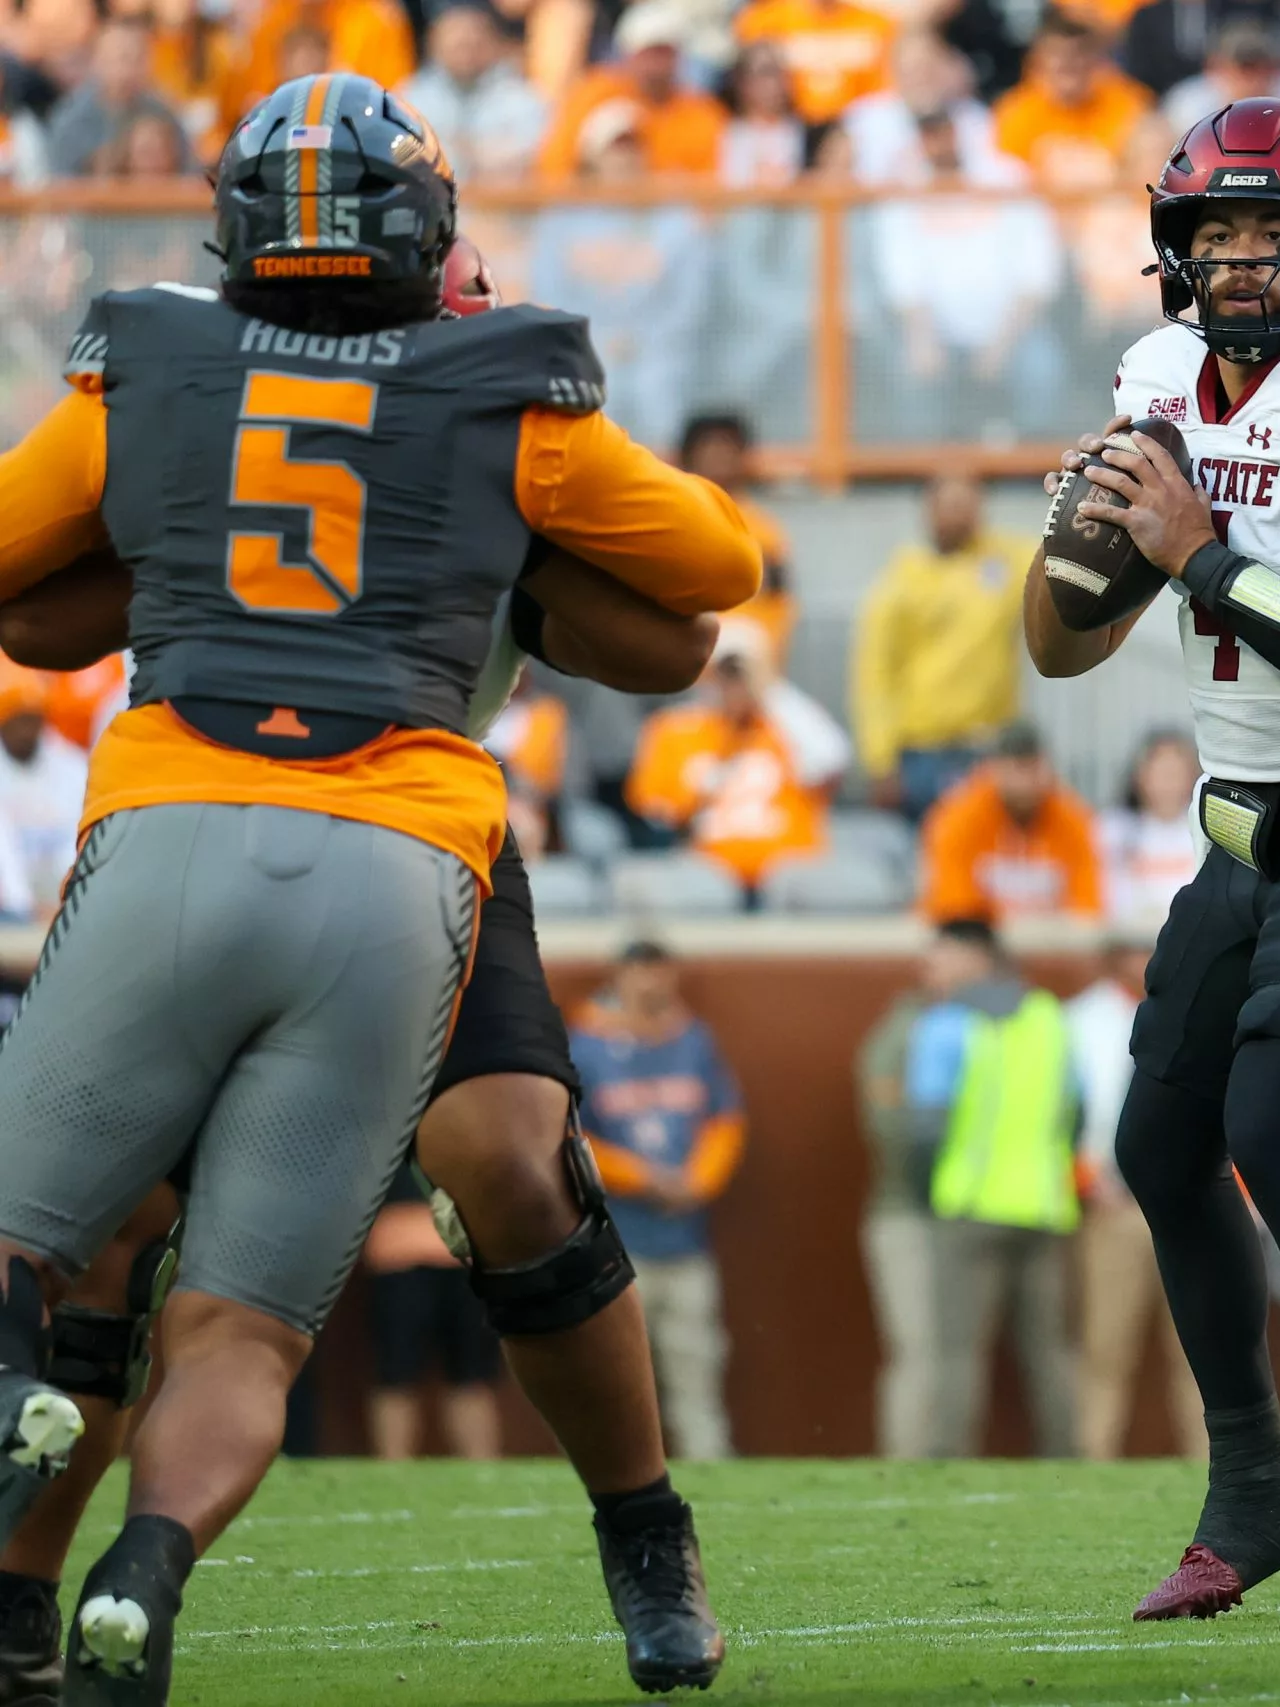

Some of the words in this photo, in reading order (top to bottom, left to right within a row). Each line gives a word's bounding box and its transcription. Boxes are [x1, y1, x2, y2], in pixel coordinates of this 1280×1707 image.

[334, 196, 360, 248] 5
[254, 256, 372, 278] TENNESSEE
[1164, 247, 1192, 288] Ridell
[226, 370, 377, 615] 5
[1198, 458, 1280, 507] STATE
